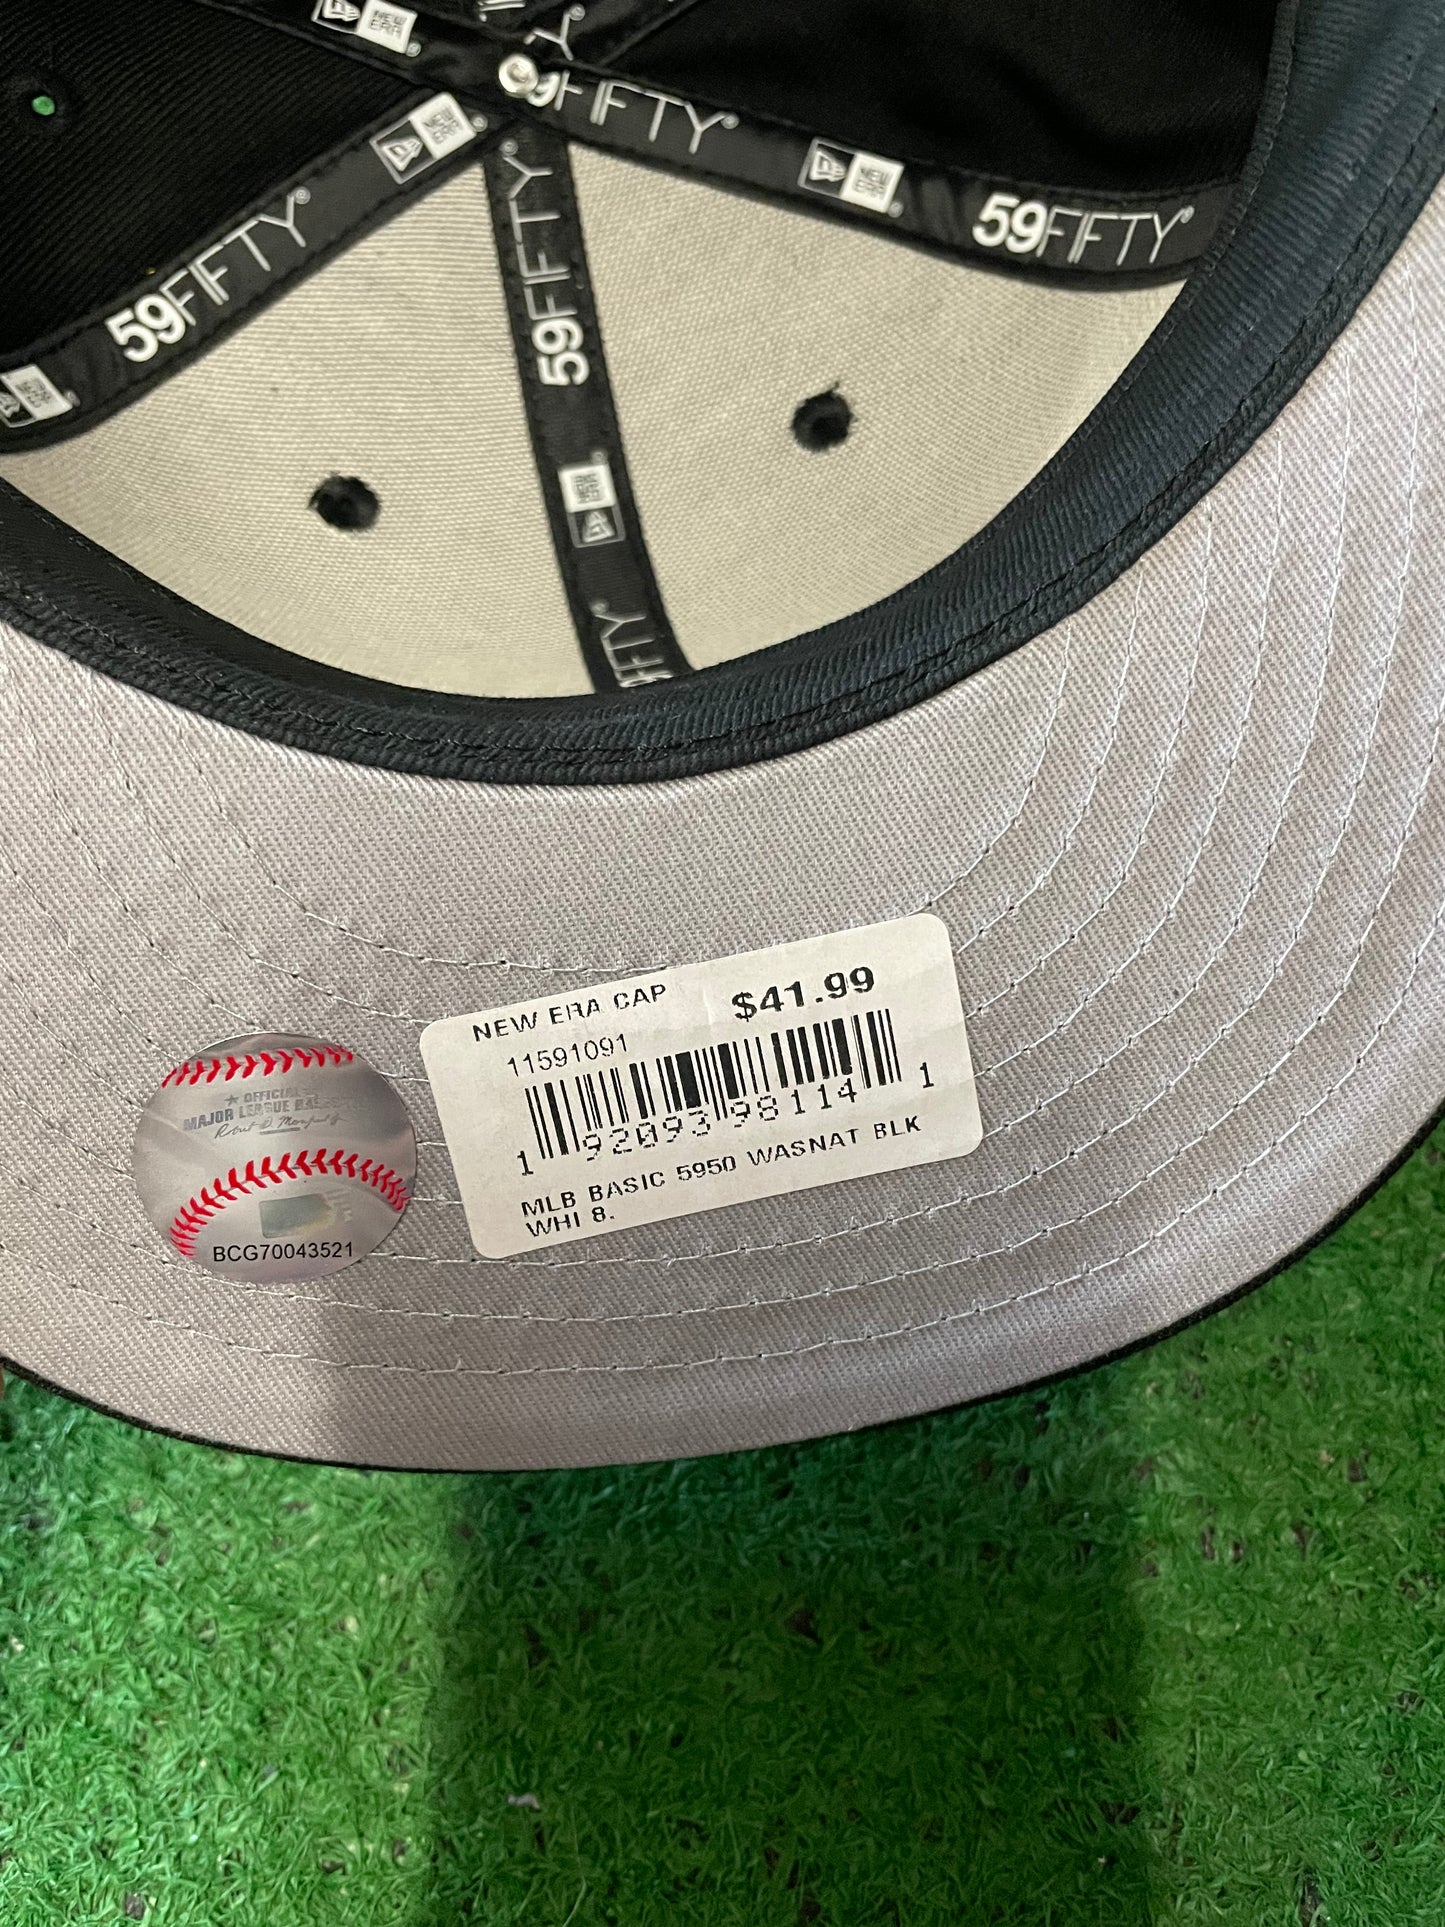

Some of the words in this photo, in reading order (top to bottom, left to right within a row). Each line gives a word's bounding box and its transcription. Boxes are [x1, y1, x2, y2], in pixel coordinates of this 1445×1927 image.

[972, 193, 1187, 266] 59FIFTY
[105, 193, 307, 362] 59FIFTY
[502, 155, 590, 386] 59FIFTY
[472, 1010, 539, 1043] NEW
[548, 998, 602, 1025] ERA
[612, 983, 667, 1010] CAP
[731, 966, 875, 1022] $41.99
[506, 1033, 628, 1078] 11591091
[183, 1108, 234, 1131] MAJOR
[517, 1150, 534, 1176] 1
[582, 1105, 712, 1162] 92093
[730, 1077, 858, 1129] 98114
[919, 1061, 935, 1089] 1
[521, 1190, 577, 1218] MLB
[588, 1170, 666, 1202] BASIC
[676, 1154, 737, 1181] 5950
[747, 1128, 859, 1167] WASNAT
[873, 1115, 922, 1140] BLK
[213, 1241, 354, 1262] BCG70043521
[525, 1210, 581, 1238] WHI
[591, 1206, 615, 1223] 8.
